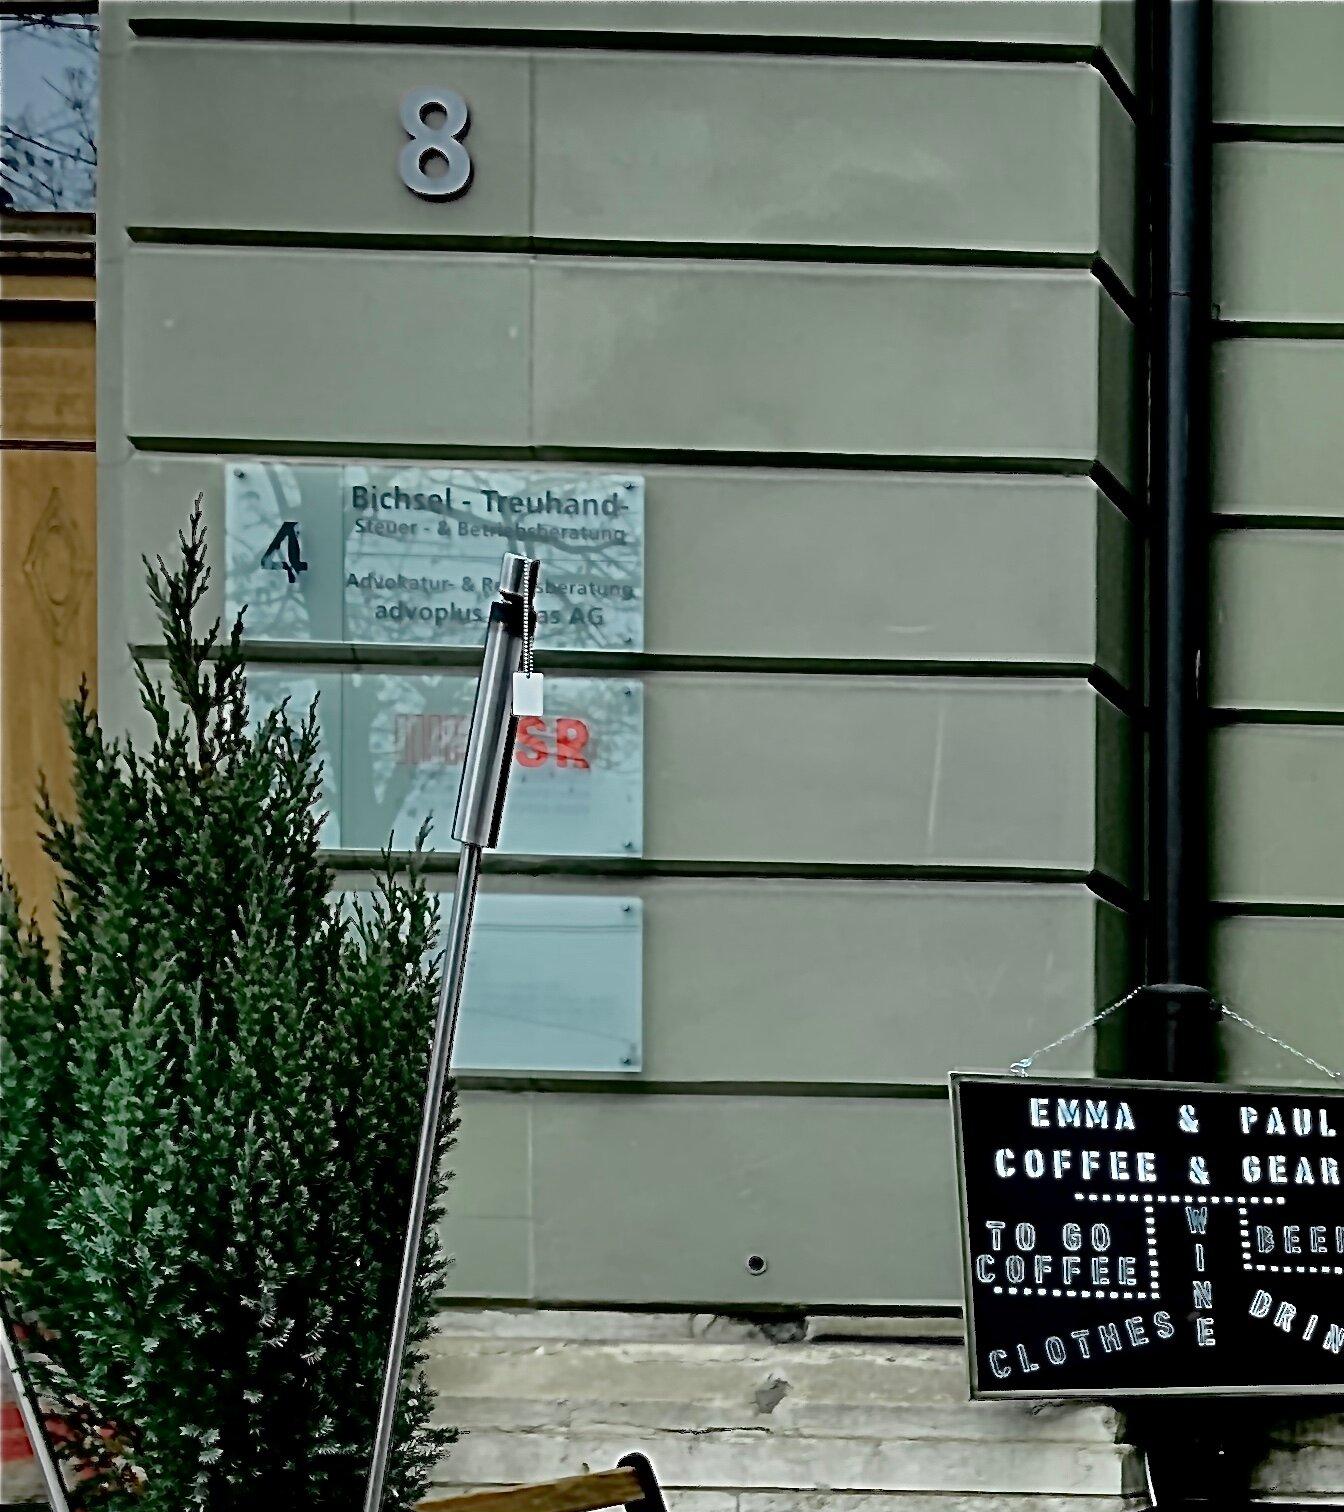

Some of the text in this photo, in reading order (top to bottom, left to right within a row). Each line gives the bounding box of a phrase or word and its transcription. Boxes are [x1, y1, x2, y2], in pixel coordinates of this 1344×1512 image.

[400, 87, 474, 203] 8
[352, 485, 451, 511] Bichsel
[480, 489, 629, 516] Treuhand-
[355, 518, 417, 535] Steuer
[437, 520, 450, 536] &
[458, 520, 628, 545] Betriebsberatung
[260, 521, 308, 584] 4
[461, 576, 475, 592] &
[375, 602, 482, 625] advoplus
[568, 606, 604, 625] AG
[1030, 1098, 1337, 1137] EMMA & PAUL
[995, 1148, 1341, 1185] COFFEE & GEAR
[986, 1220, 1111, 1252] TO GO
[976, 1254, 1137, 1286] COFFEE
[1185, 1206, 1216, 1347] WINE
[988, 1310, 1175, 1379] CLOTHES
